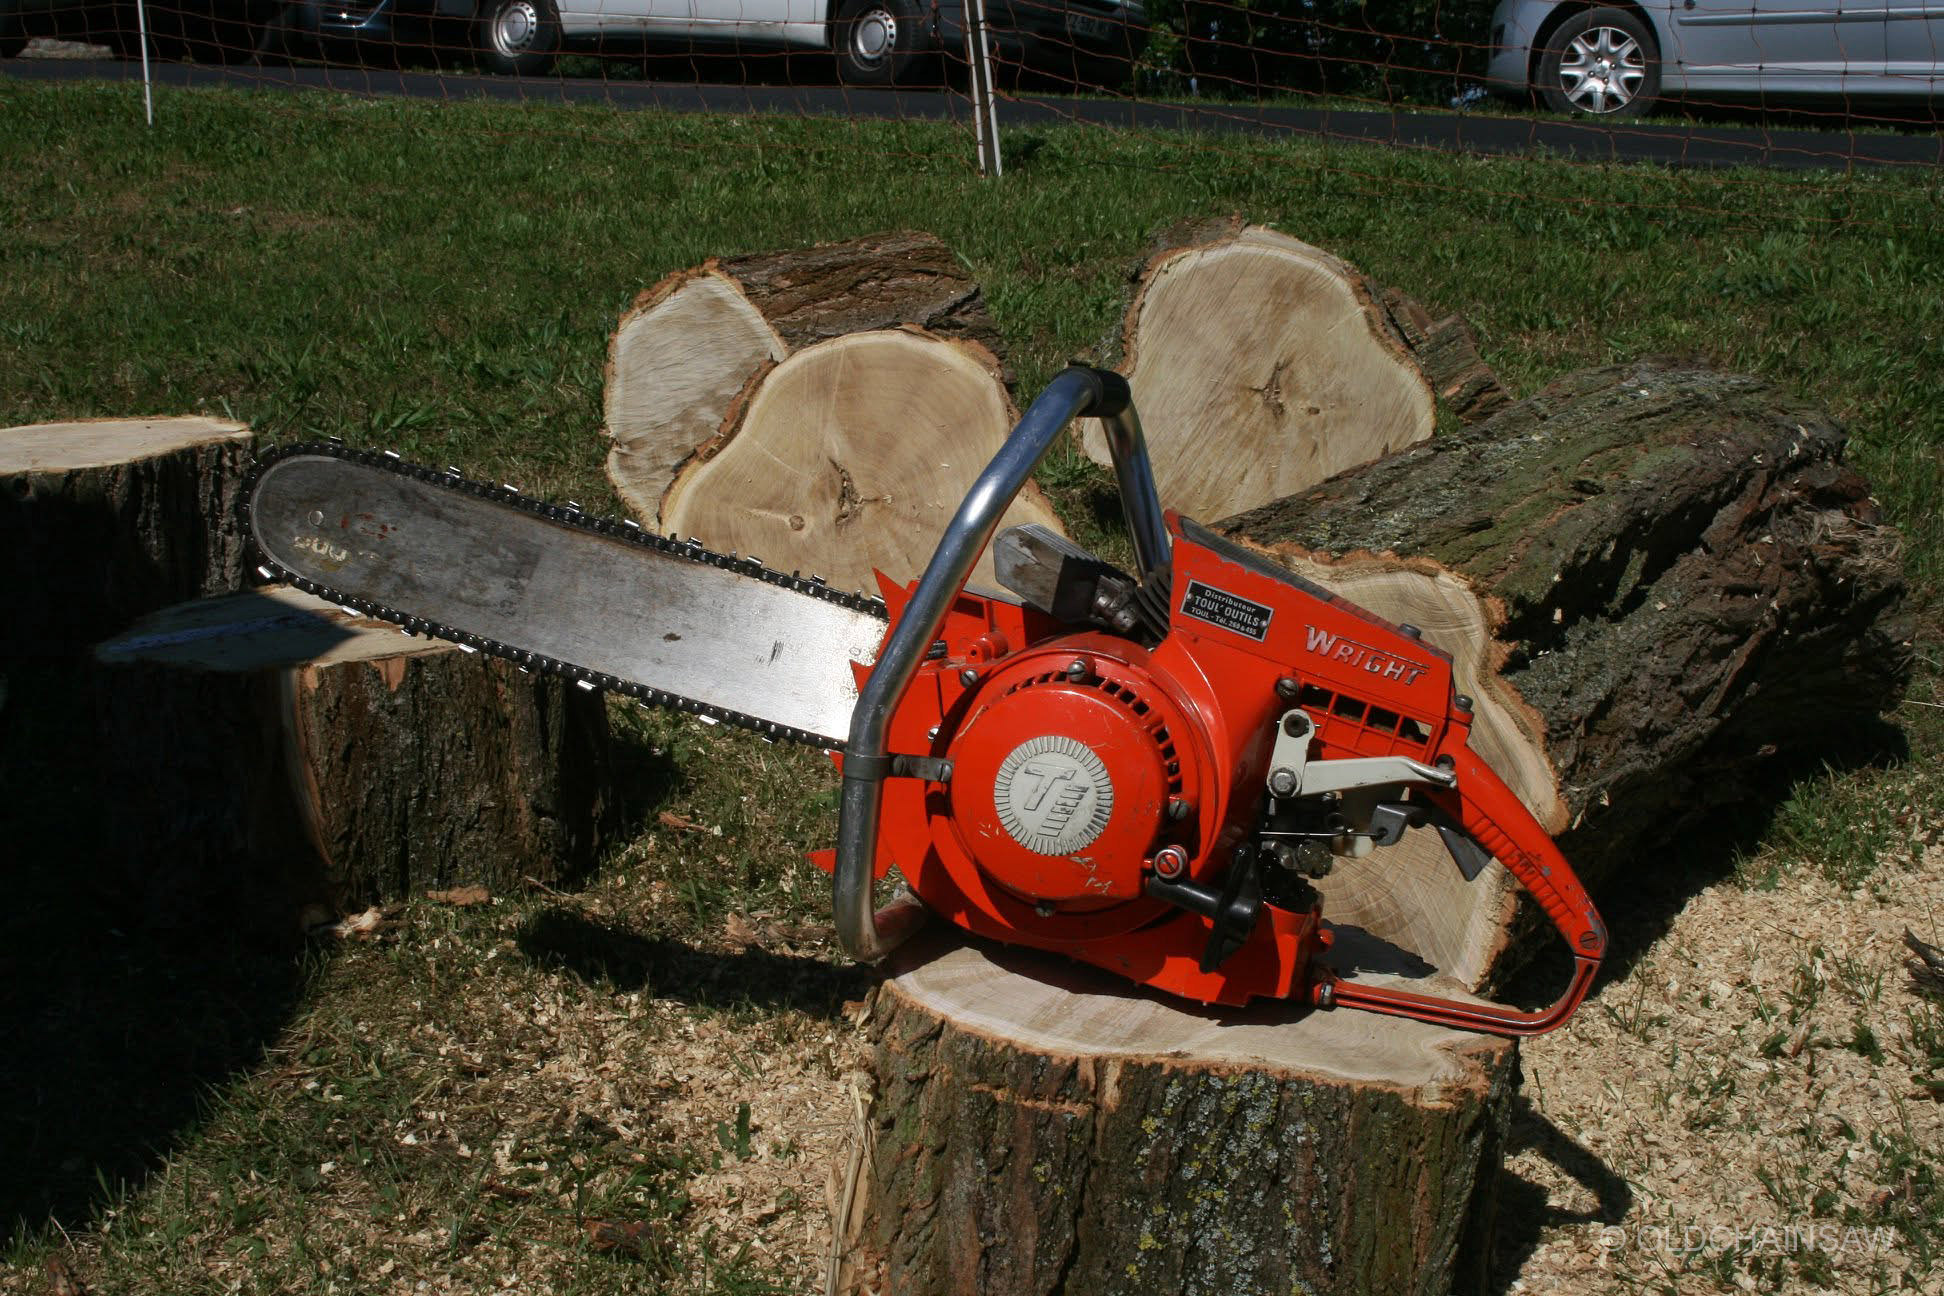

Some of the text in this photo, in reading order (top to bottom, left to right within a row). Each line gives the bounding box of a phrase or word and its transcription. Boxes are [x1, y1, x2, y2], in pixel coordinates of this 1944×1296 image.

[1204, 589, 1257, 613] Distributeur
[1191, 606, 1210, 619] TOUL
[1224, 606, 1260, 627] OUTILS
[1304, 624, 1425, 686] WRIGHT
